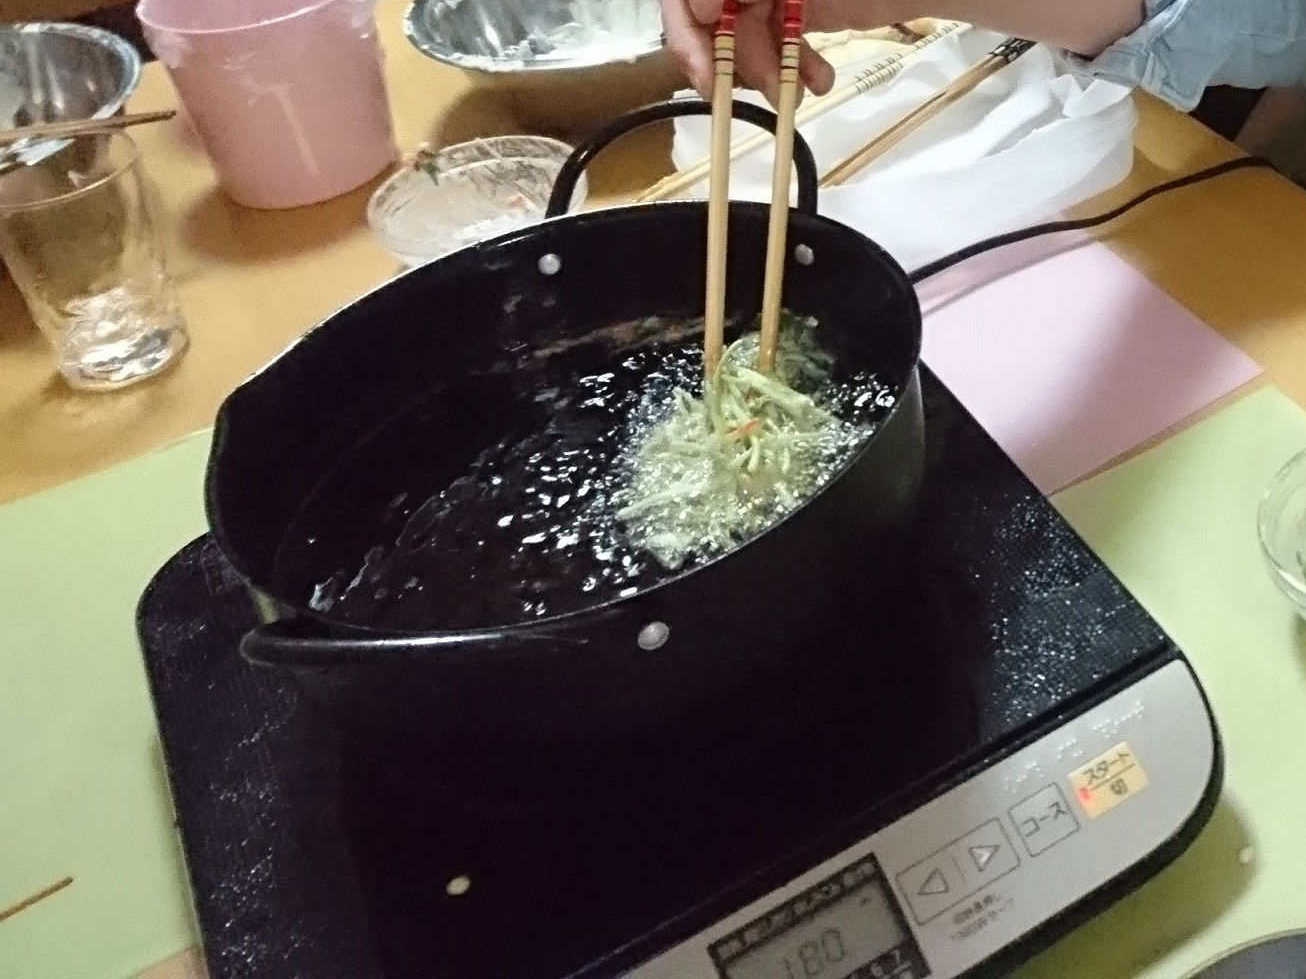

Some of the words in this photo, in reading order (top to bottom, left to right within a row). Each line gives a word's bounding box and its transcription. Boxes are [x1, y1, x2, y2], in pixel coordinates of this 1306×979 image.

[1082, 751, 1131, 786] スタート
[1020, 802, 1067, 838] コース
